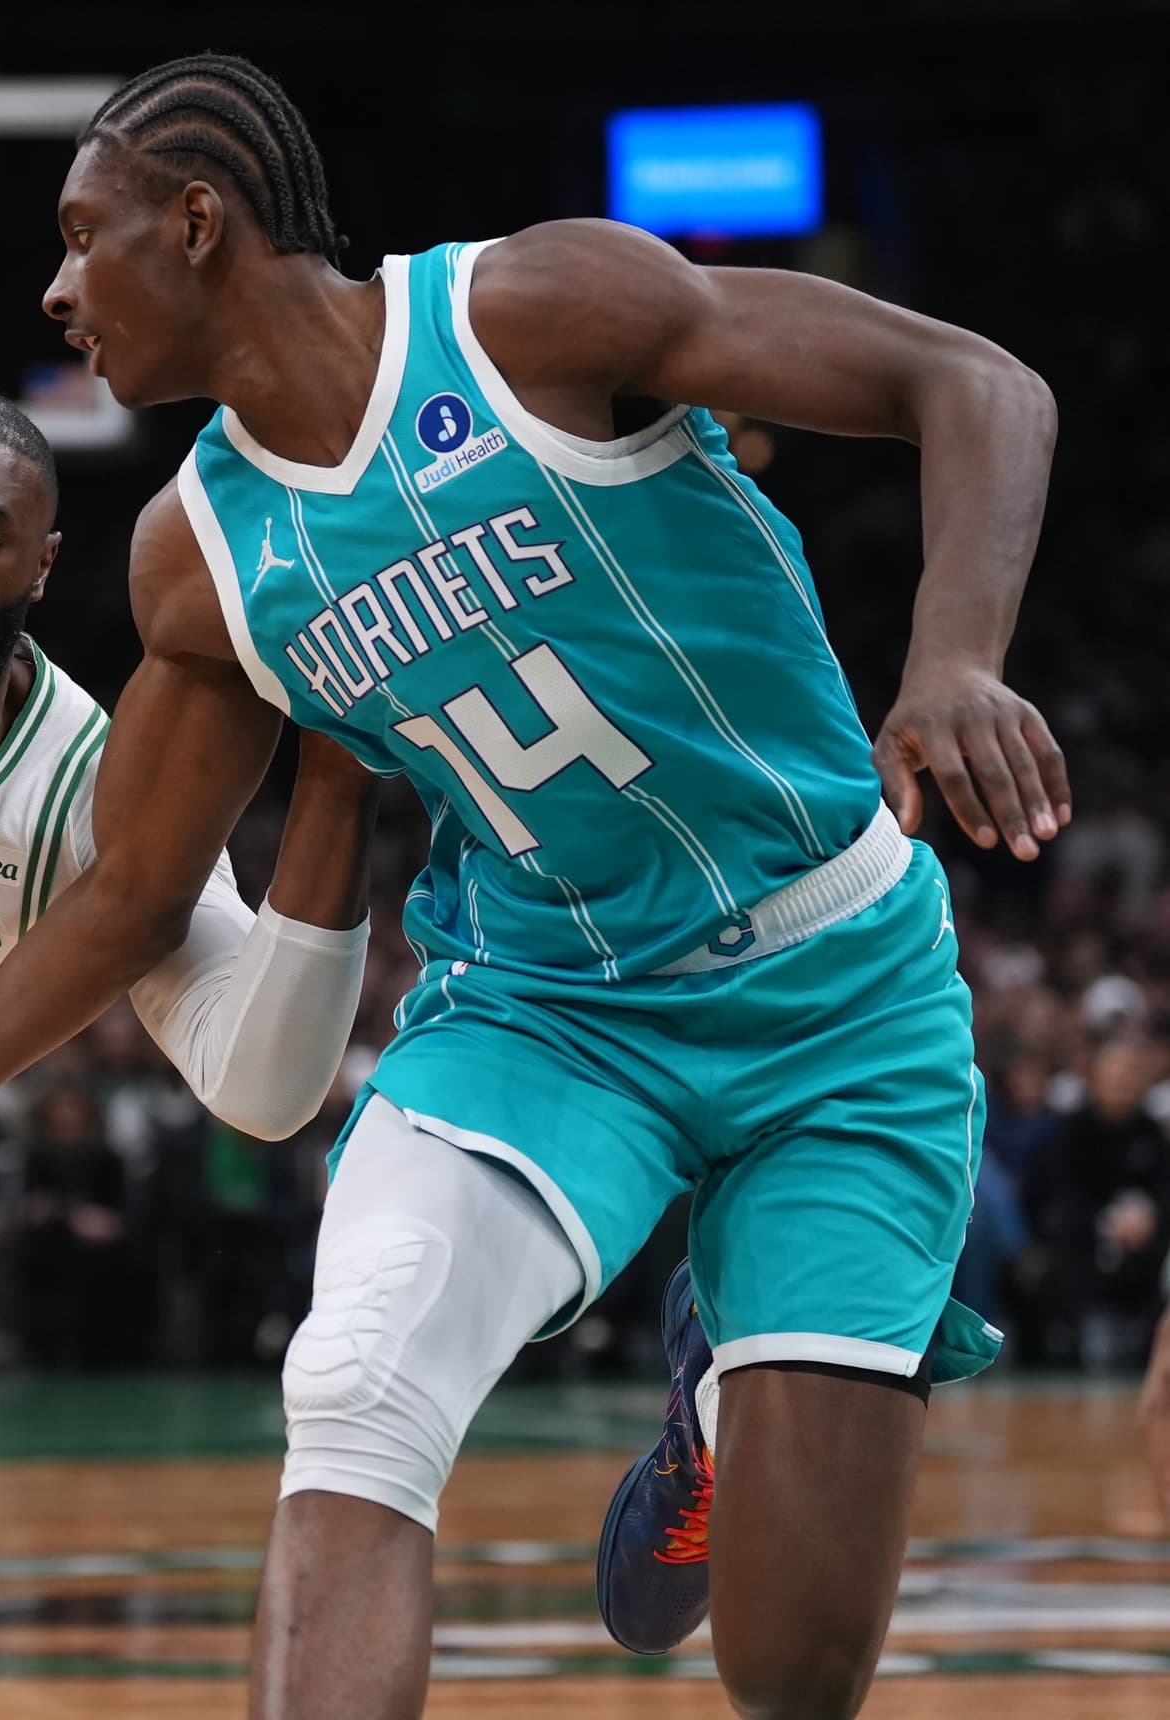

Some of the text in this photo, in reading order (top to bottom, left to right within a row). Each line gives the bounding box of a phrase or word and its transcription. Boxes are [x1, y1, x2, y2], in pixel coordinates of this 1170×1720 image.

[422, 432, 506, 488] Judi Health
[285, 505, 575, 718] HORNETS
[389, 641, 656, 858] 14
